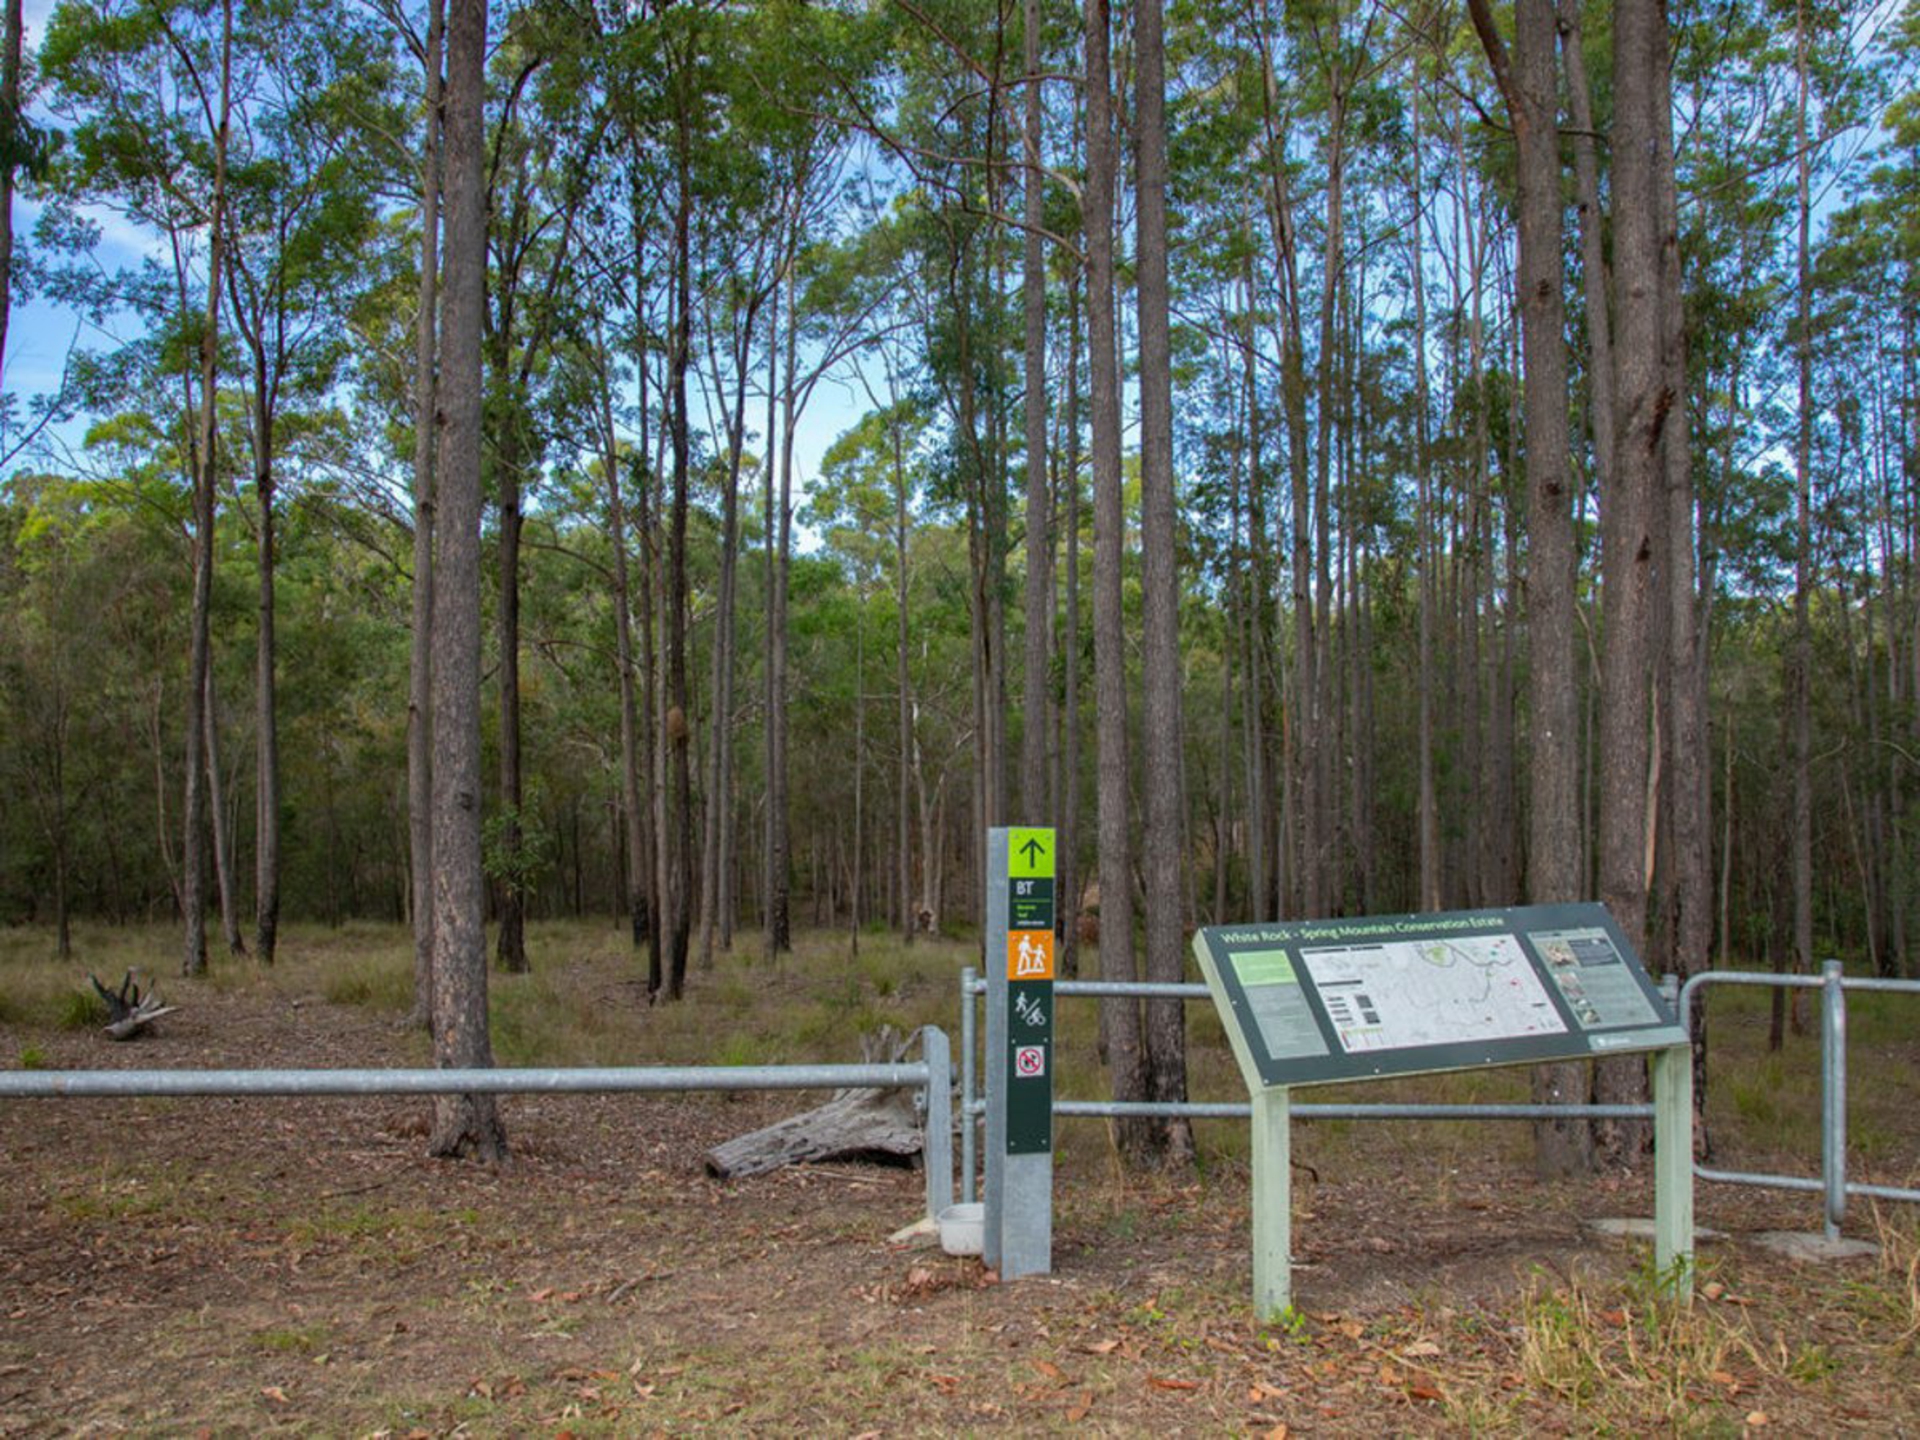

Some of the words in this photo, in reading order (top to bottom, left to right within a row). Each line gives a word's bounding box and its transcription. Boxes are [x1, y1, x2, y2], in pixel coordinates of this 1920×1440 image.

[1016, 880, 1035, 895] BT
[1220, 931, 1259, 943] White
[1260, 930, 1291, 942] Rock
[1300, 927, 1340, 941] Spring
[1340, 923, 1394, 936] Mountain
[1395, 919, 1469, 932] Conservation
[1469, 917, 1504, 928] Estate
